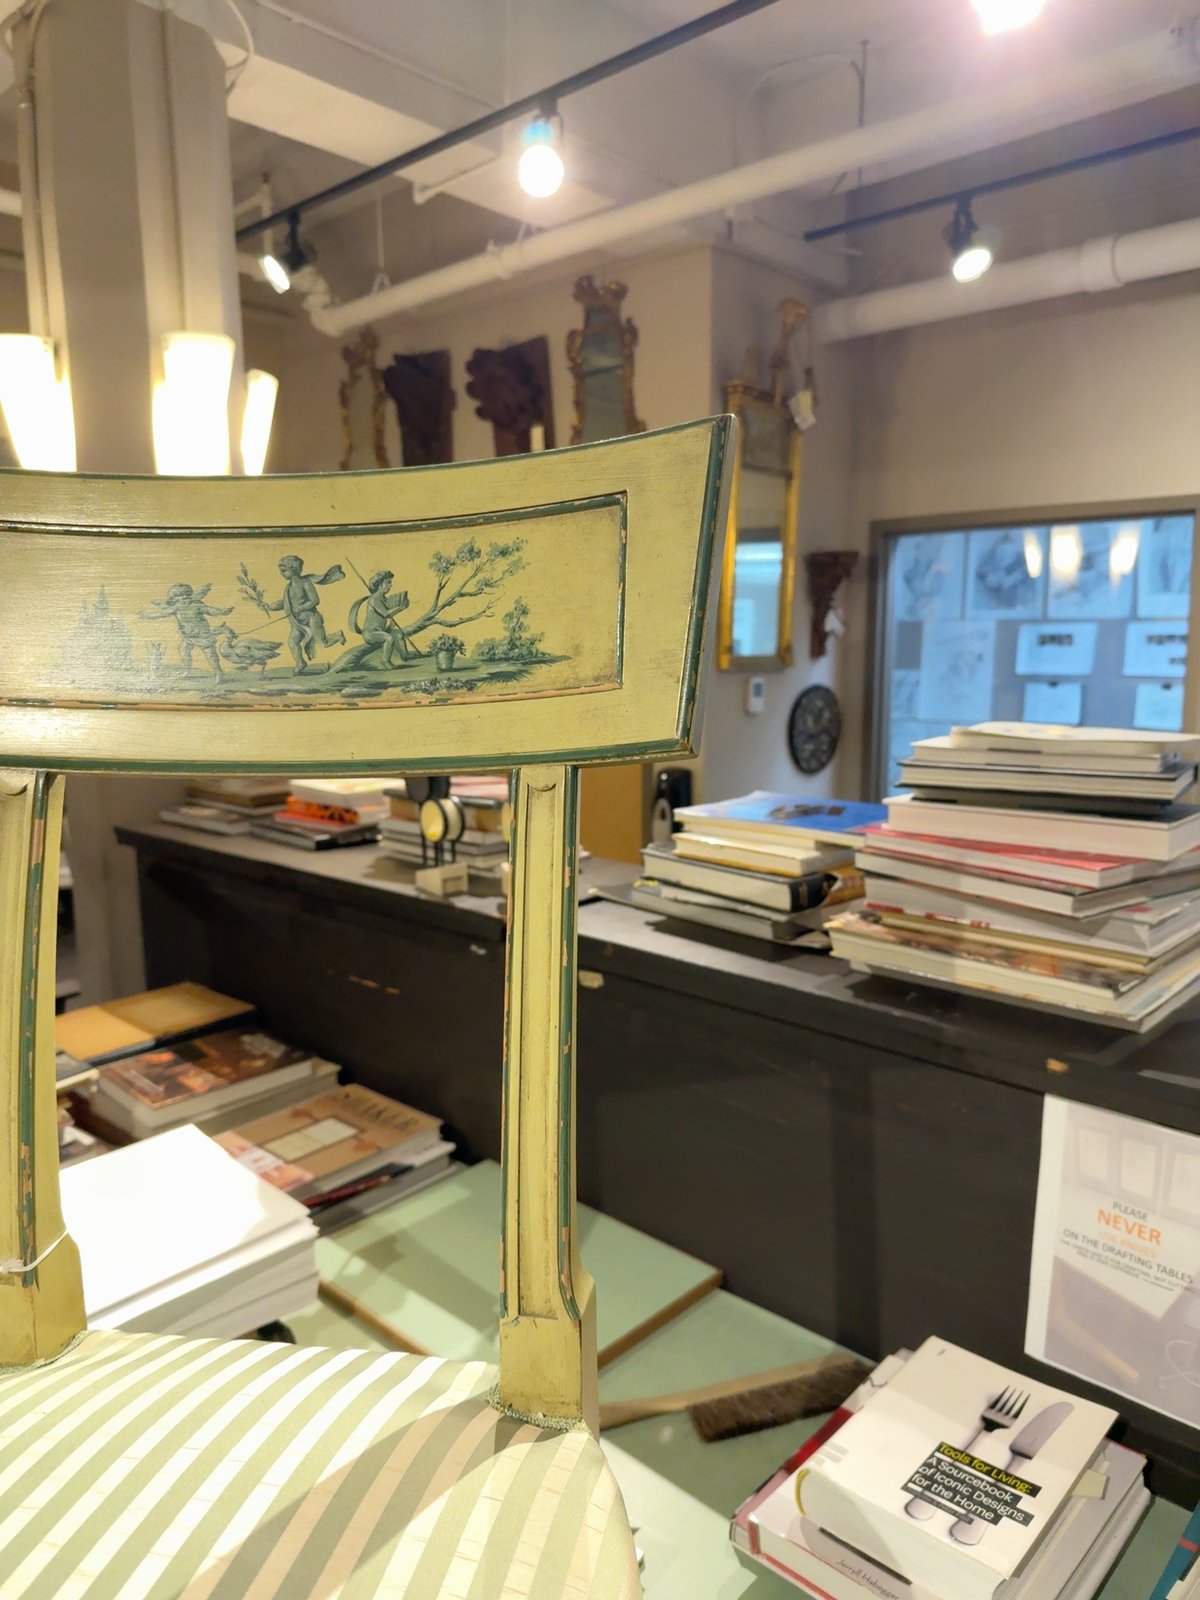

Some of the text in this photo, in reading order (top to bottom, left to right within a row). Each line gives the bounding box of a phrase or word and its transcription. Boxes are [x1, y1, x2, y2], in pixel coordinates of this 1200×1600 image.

[1097, 1208, 1162, 1246] NEVER
[1112, 1201, 1148, 1221] PLEASE
[1063, 1228, 1079, 1241] ON
[1081, 1234, 1099, 1249] THE
[1102, 1242, 1153, 1270] DRAFTING
[1155, 1263, 1194, 1284] TABLES
[926, 1457, 1014, 1503] A Sourcebook
[939, 1444, 1033, 1494] Tools for Living:
[912, 1473, 932, 1487] for
[931, 1482, 953, 1499] the
[953, 1494, 995, 1520] Home
[918, 1466, 937, 1476] of
[934, 1471, 972, 1495] Iconic
[973, 1491, 1025, 1521] Designs
